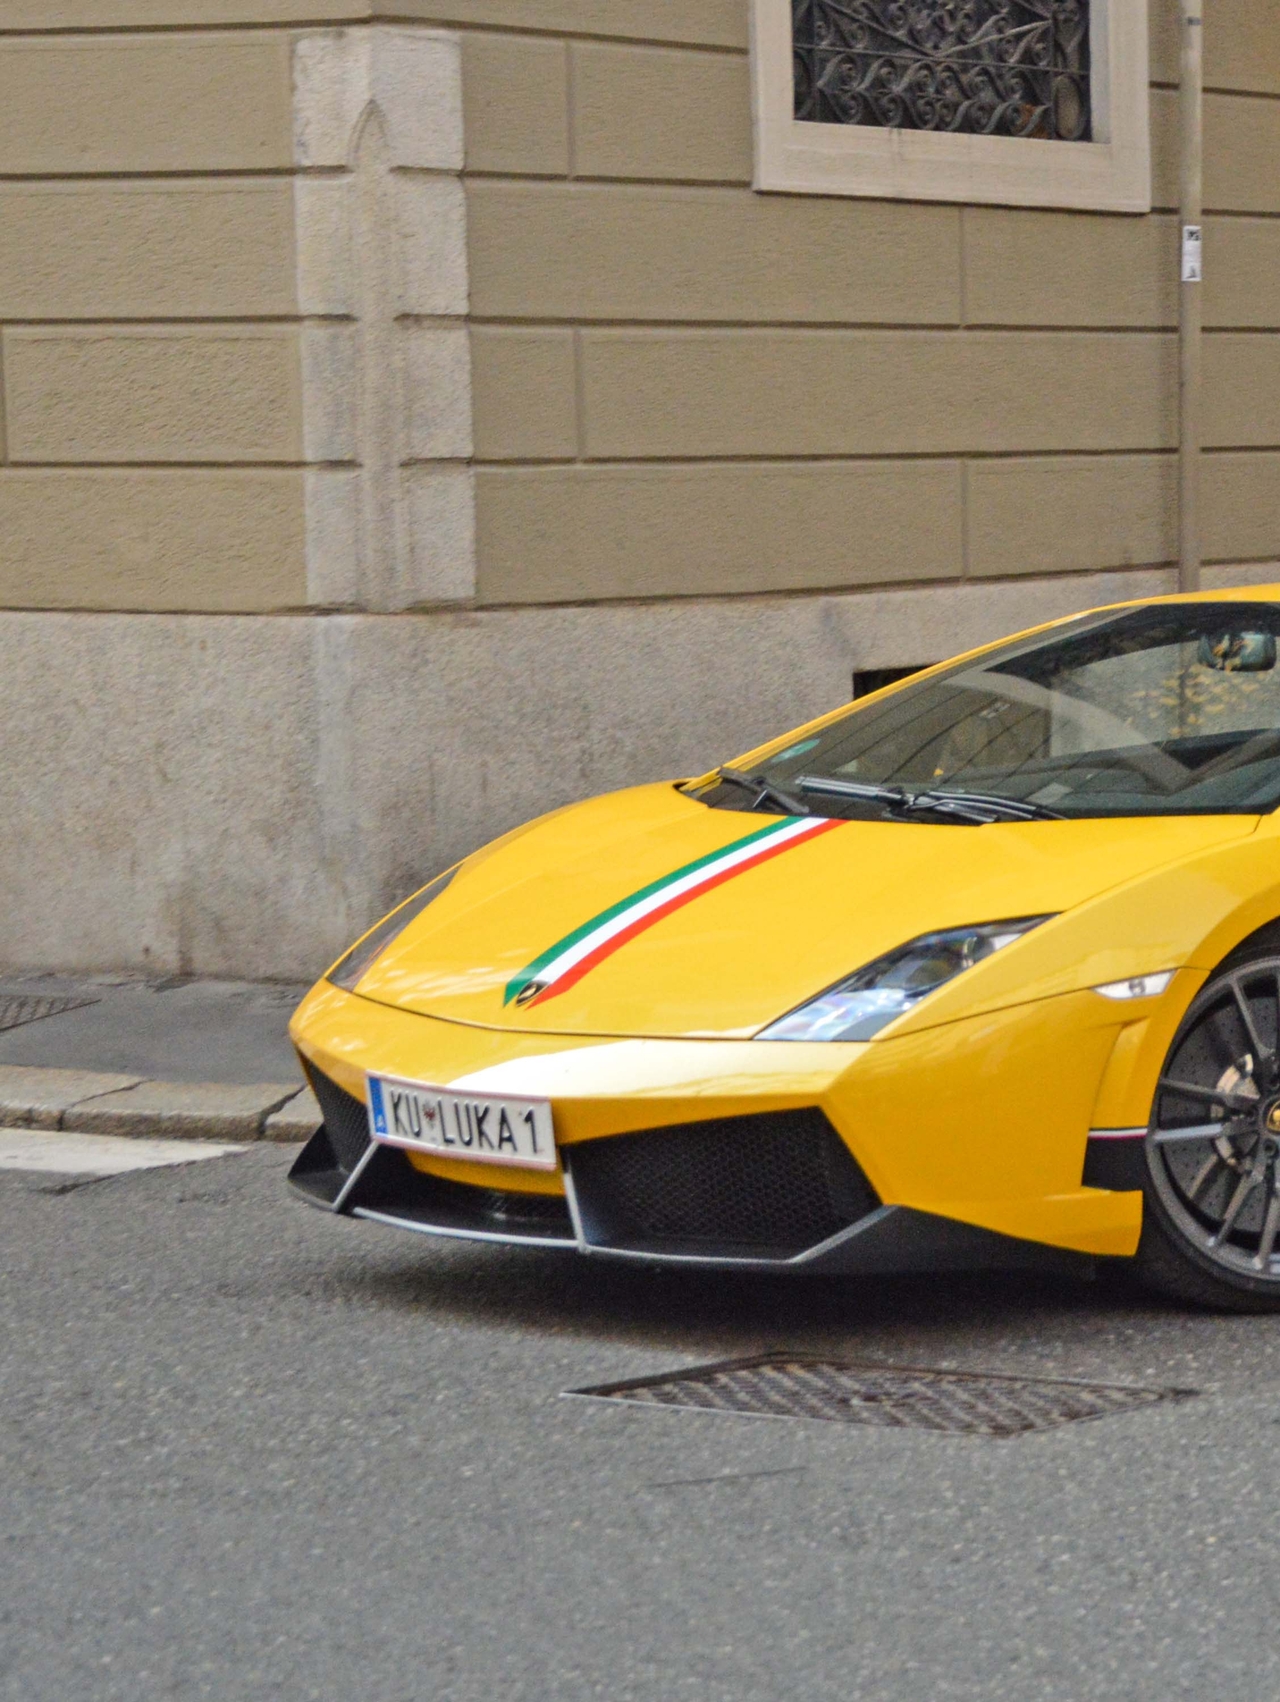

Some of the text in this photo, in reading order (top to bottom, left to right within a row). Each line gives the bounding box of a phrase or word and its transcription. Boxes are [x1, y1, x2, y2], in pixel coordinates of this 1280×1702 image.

[390, 1089, 538, 1154] KU LUKA 1
